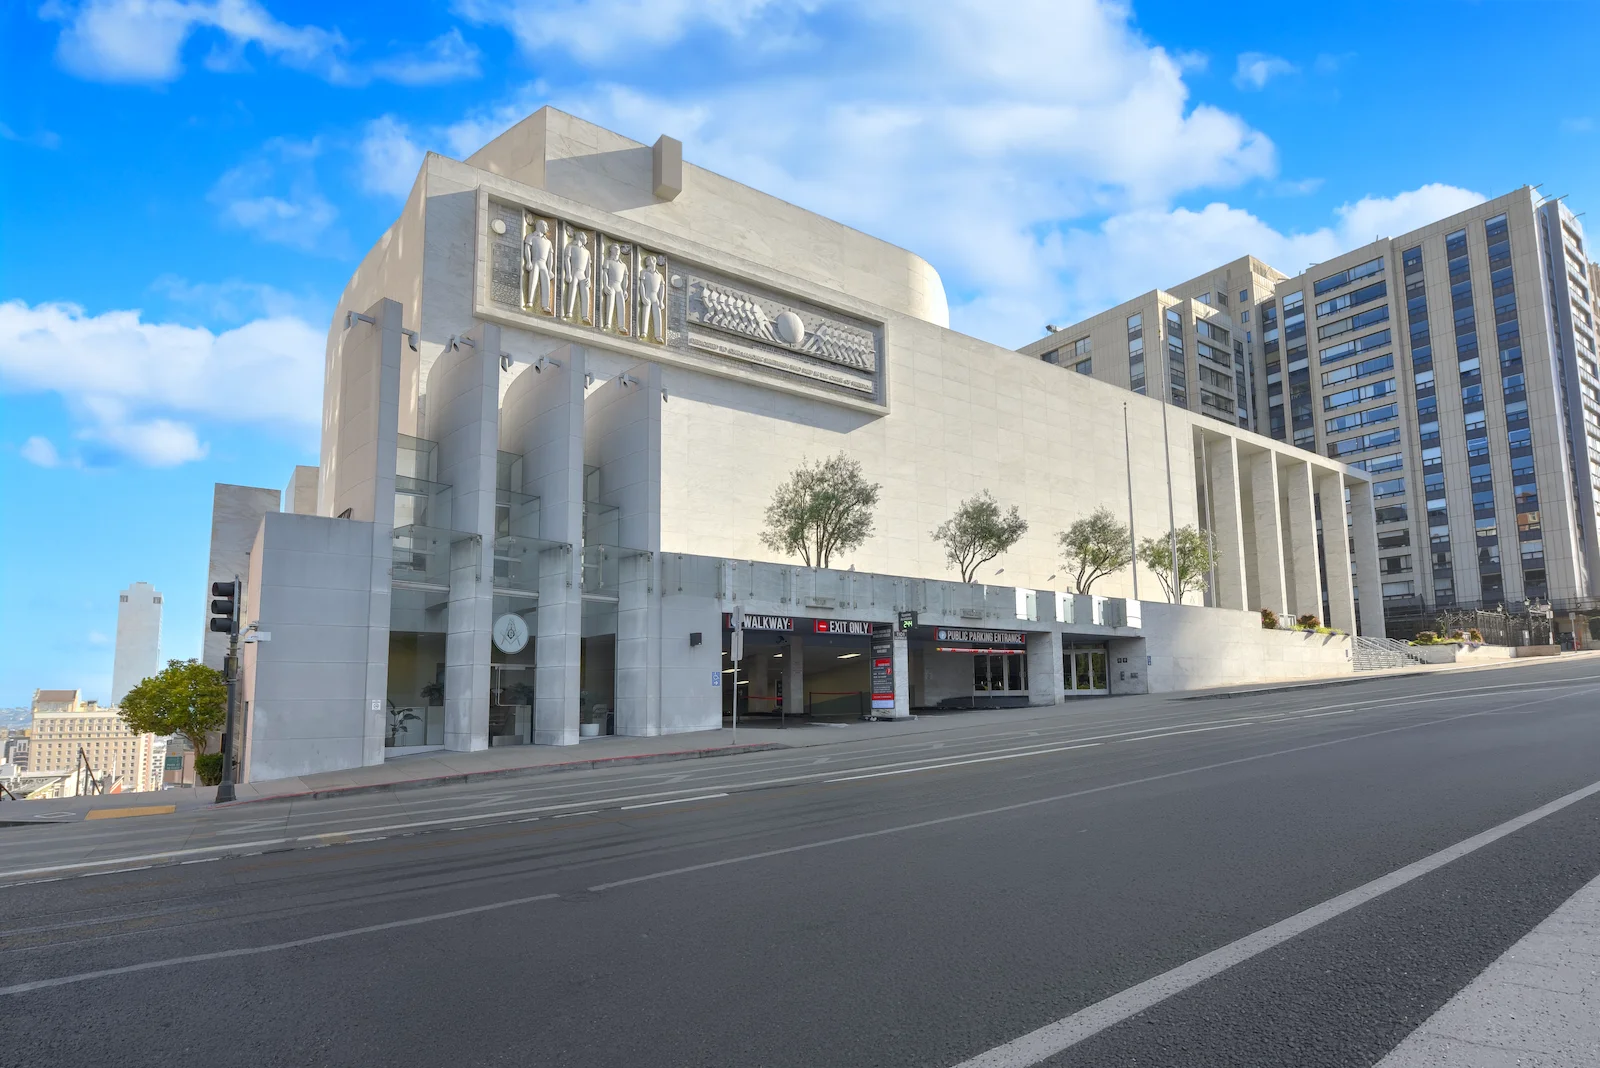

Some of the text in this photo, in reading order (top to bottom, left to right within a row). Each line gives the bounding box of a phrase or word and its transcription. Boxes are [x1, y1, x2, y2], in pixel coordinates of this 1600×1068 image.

[744, 616, 788, 630] WALKWAY
[830, 621, 868, 634] EXIT ONLY
[947, 630, 968, 641] PUBLIC
[969, 631, 993, 642] PARKING
[994, 632, 1022, 643] ENTRANCE
